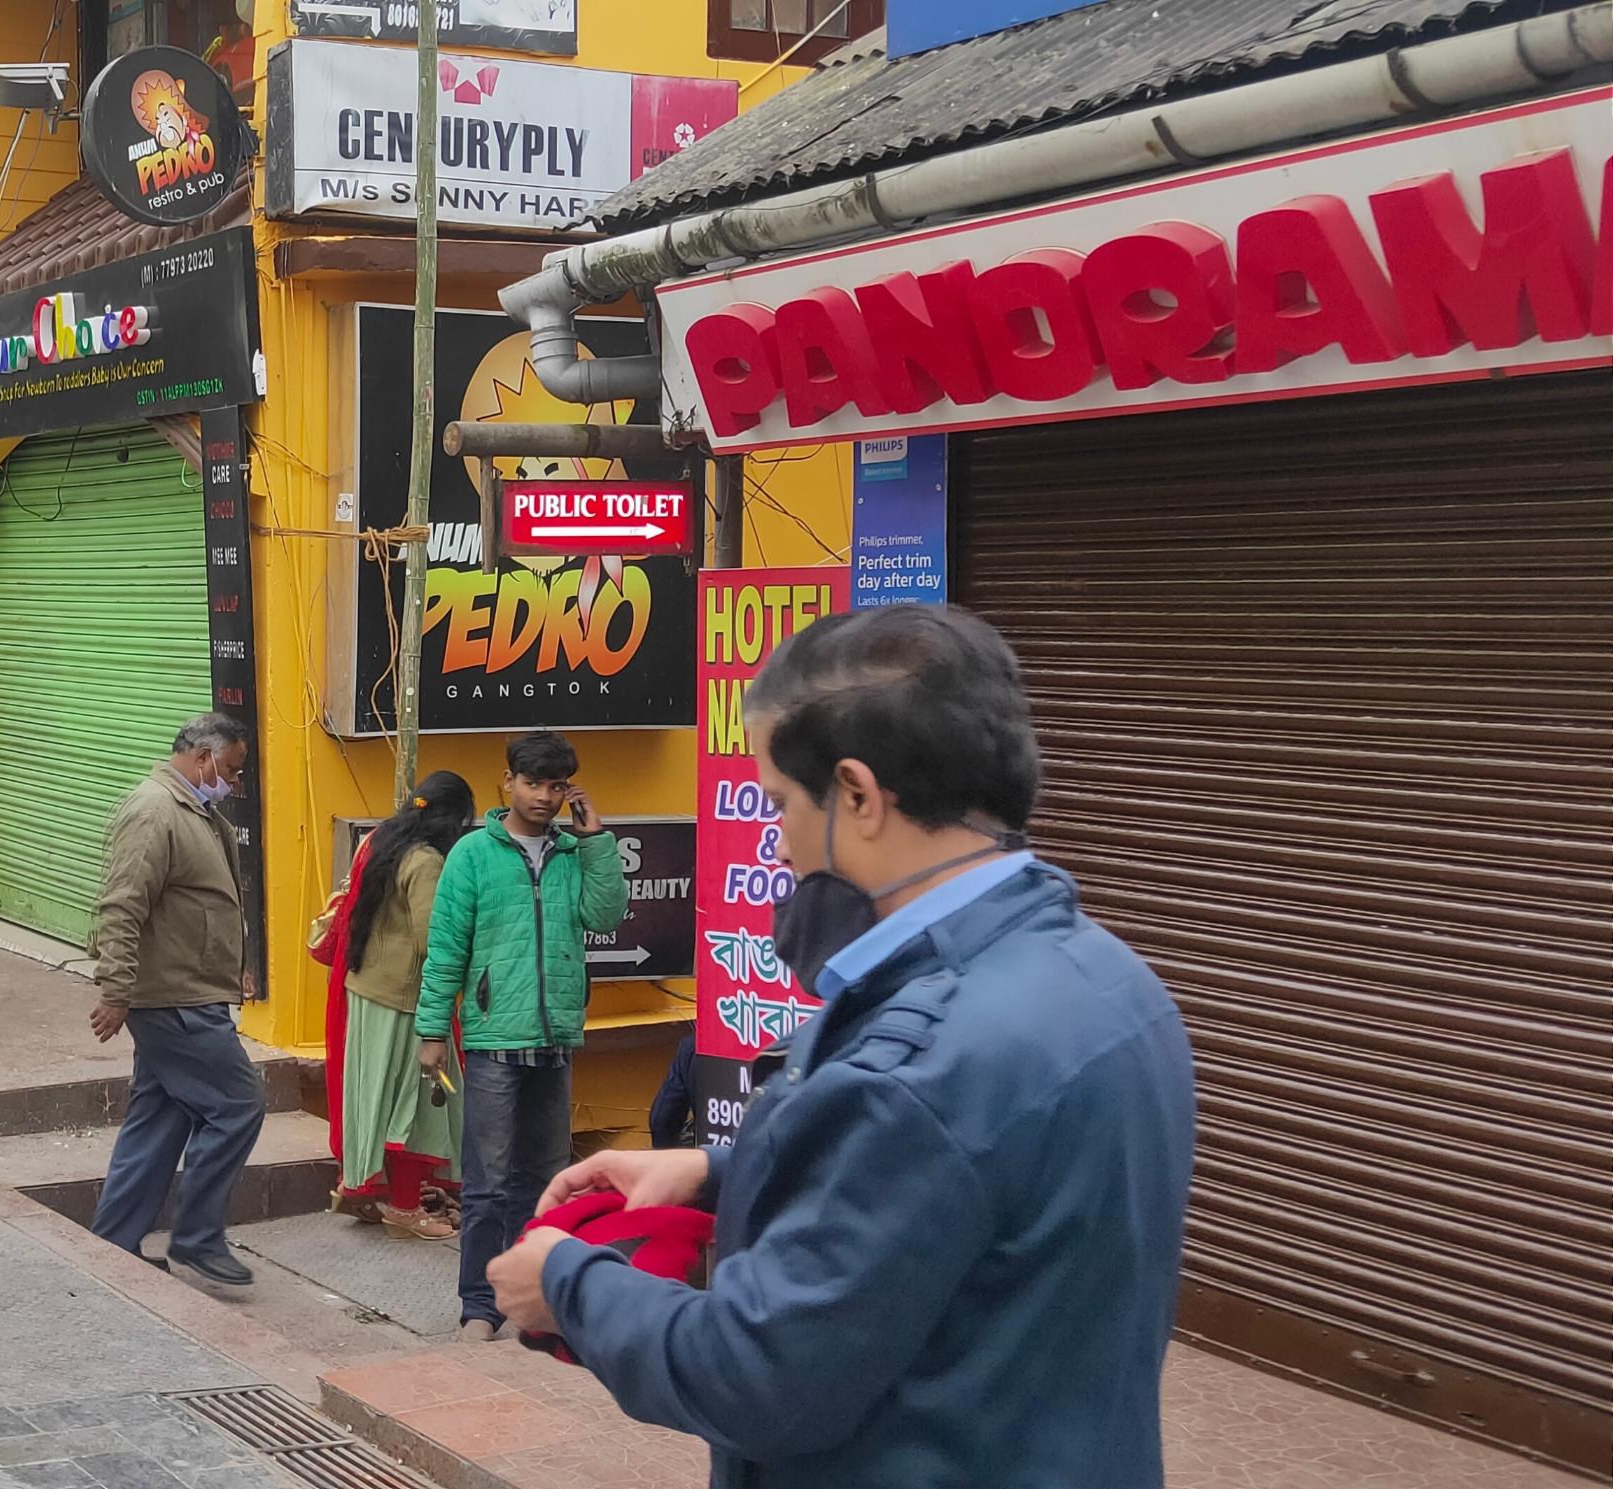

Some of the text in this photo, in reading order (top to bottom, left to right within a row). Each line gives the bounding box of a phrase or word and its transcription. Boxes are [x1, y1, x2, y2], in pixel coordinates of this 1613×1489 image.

[388, 4, 454, 30] 8016721
[338, 108, 588, 177] CENURYPLY
[136, 134, 215, 196] PEDRO
[643, 148, 677, 166] CEN
[148, 171, 225, 210] restro & pub
[321, 178, 606, 217] M/s SNNY HAR
[160, 256, 186, 279] 77973
[187, 247, 215, 273] 20220
[685, 147, 1613, 437] PANORAM
[91, 365, 109, 388] Baby
[131, 357, 164, 378] Concern
[864, 440, 904, 454] PHILIPS
[211, 464, 230, 484] CARE
[514, 493, 684, 518] PUBLIC TOILET
[859, 536, 888, 549] Philips
[211, 546, 238, 567] MEE MEE
[858, 552, 932, 571] Perfect trim
[857, 570, 941, 592] day after day
[858, 595, 879, 606] Lasts
[420, 566, 652, 676] PEDRO
[446, 681, 610, 698] GANGTOK
[716, 781, 784, 821] LOD
[628, 878, 691, 900] EAUTY
[725, 865, 796, 905] FOO
[707, 1098, 743, 1128] 890
